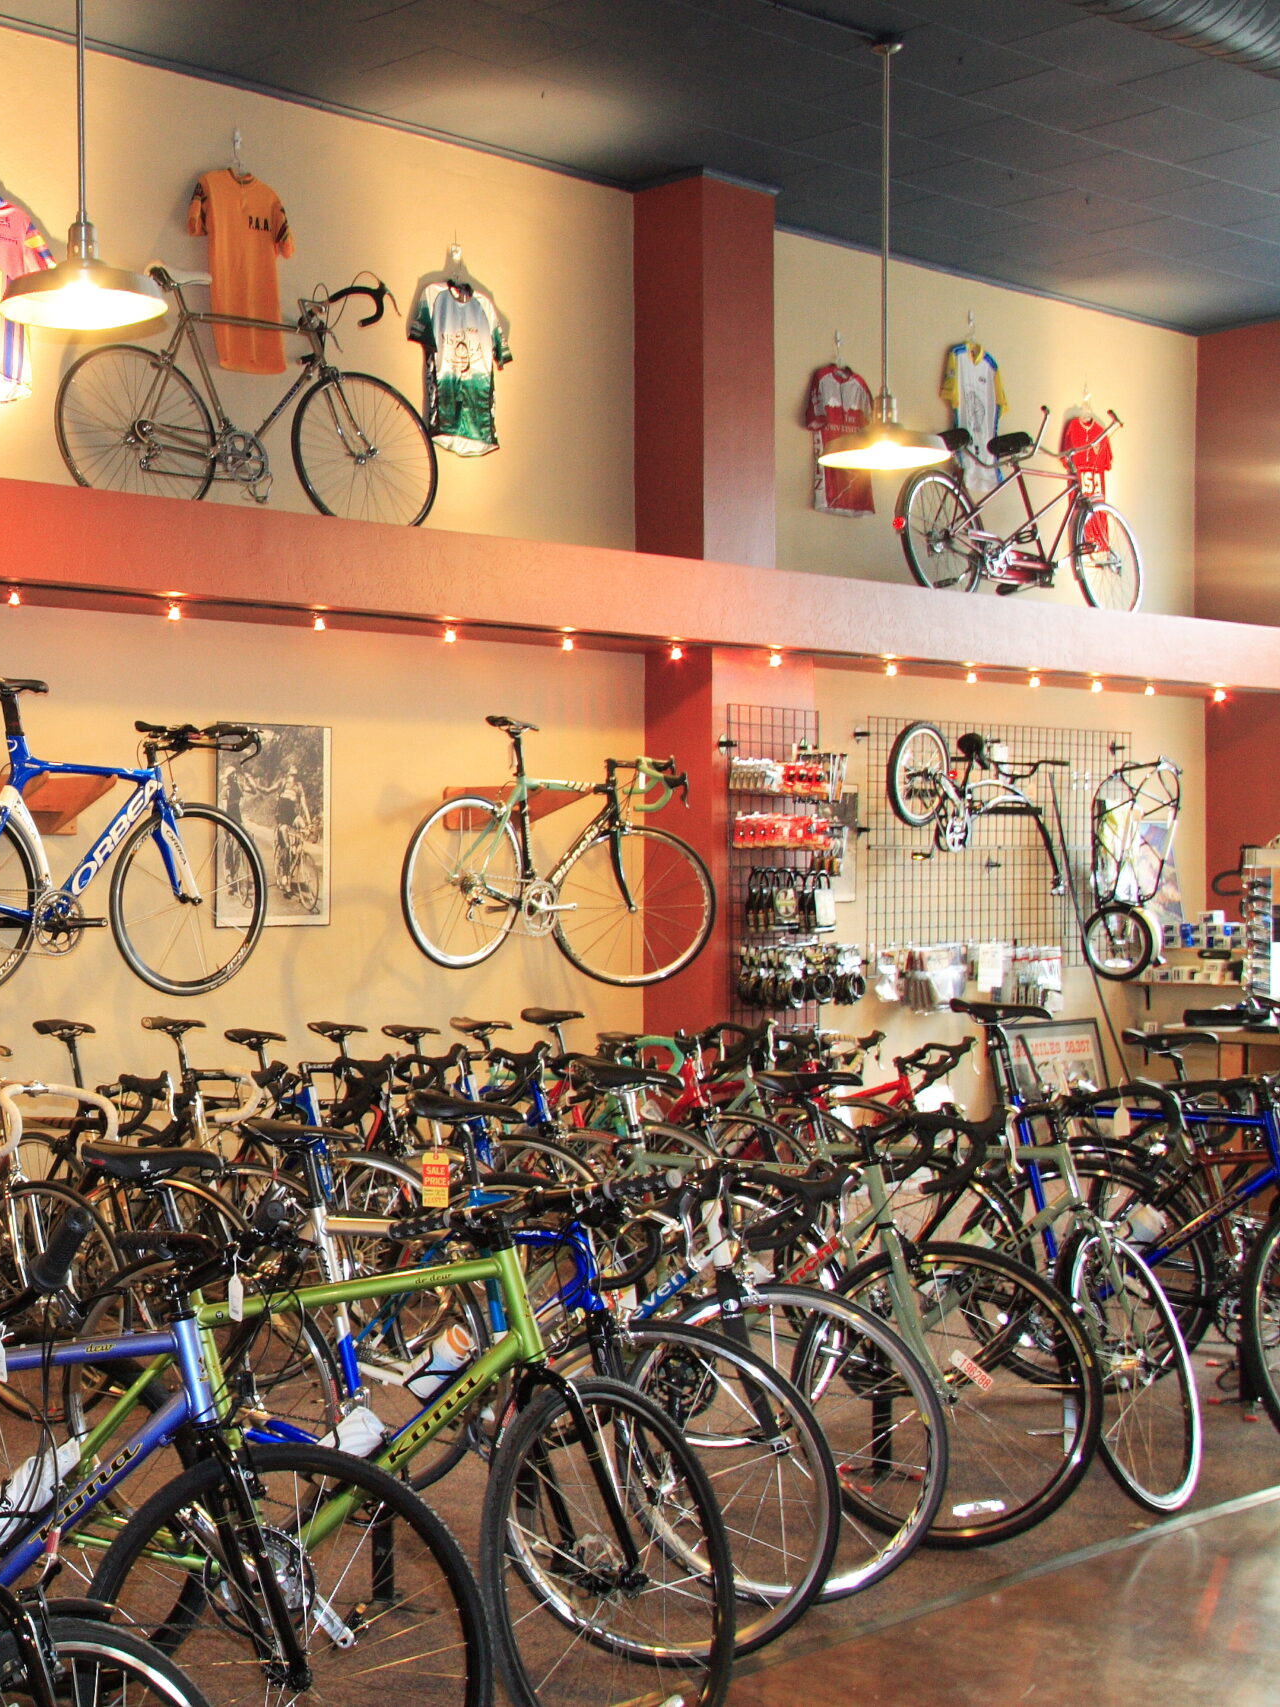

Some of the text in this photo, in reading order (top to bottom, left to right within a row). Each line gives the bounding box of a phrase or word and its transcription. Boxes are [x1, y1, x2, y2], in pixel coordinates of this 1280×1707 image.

[72, 779, 163, 896] ORBEA
[166, 829, 187, 865] ORBEA
[552, 821, 601, 886] Bianchi
[426, 1166, 445, 1176] SALE
[463, 1142, 472, 1172] seven
[424, 1176, 447, 1186] PRICE
[629, 1270, 687, 1320] even
[84, 1342, 117, 1354] dew
[959, 1358, 992, 1389] 196288
[387, 1373, 484, 1465] Kona
